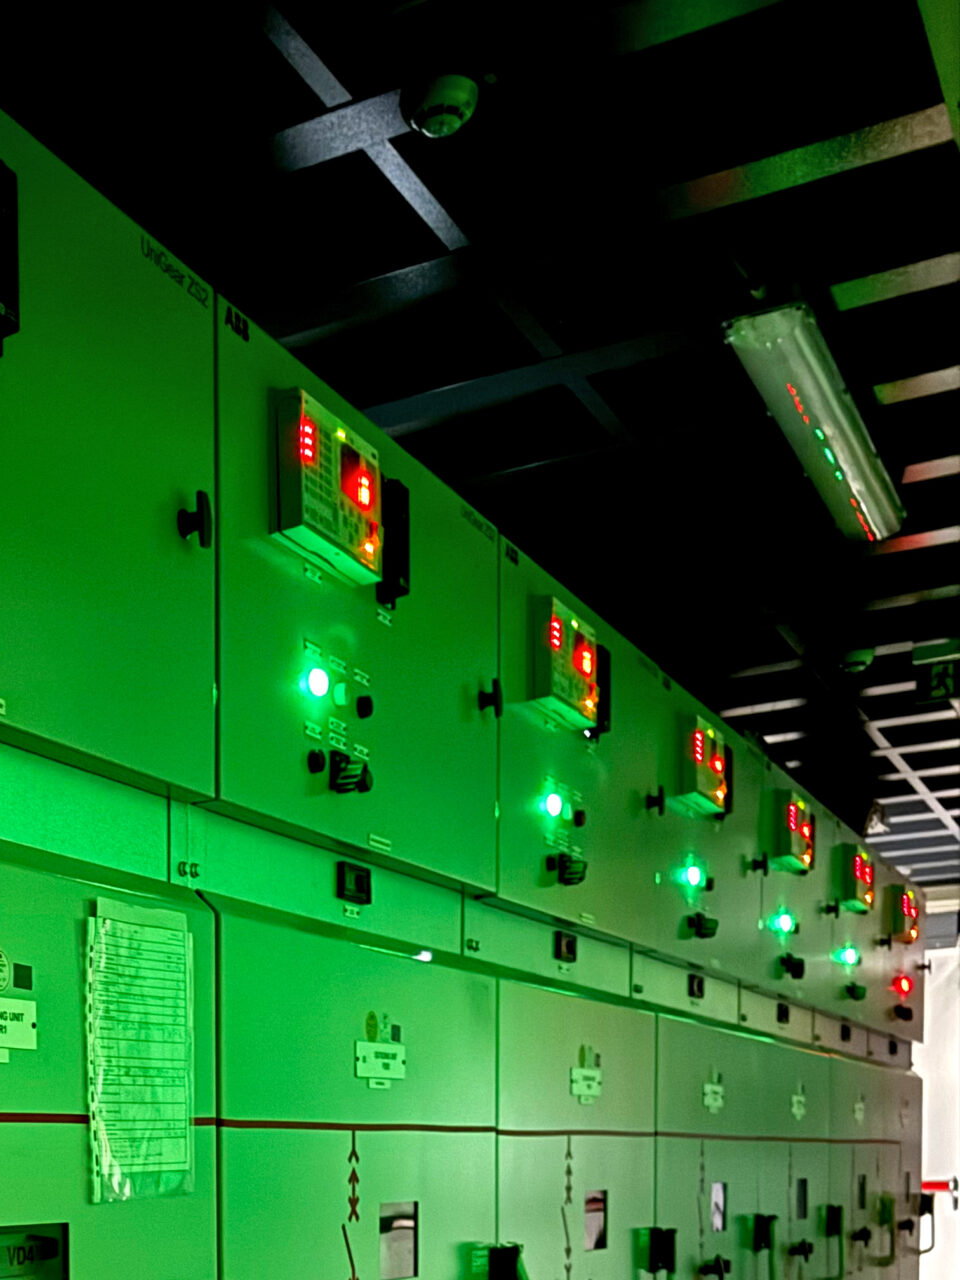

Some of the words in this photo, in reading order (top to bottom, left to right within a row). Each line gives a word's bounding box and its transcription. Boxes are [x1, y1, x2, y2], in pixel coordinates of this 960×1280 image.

[187, 275, 209, 309] ZS2
[224, 305, 250, 342] ABB
[9, 1012, 24, 1023] UNIT
[7, 1246, 34, 1266] VD4
